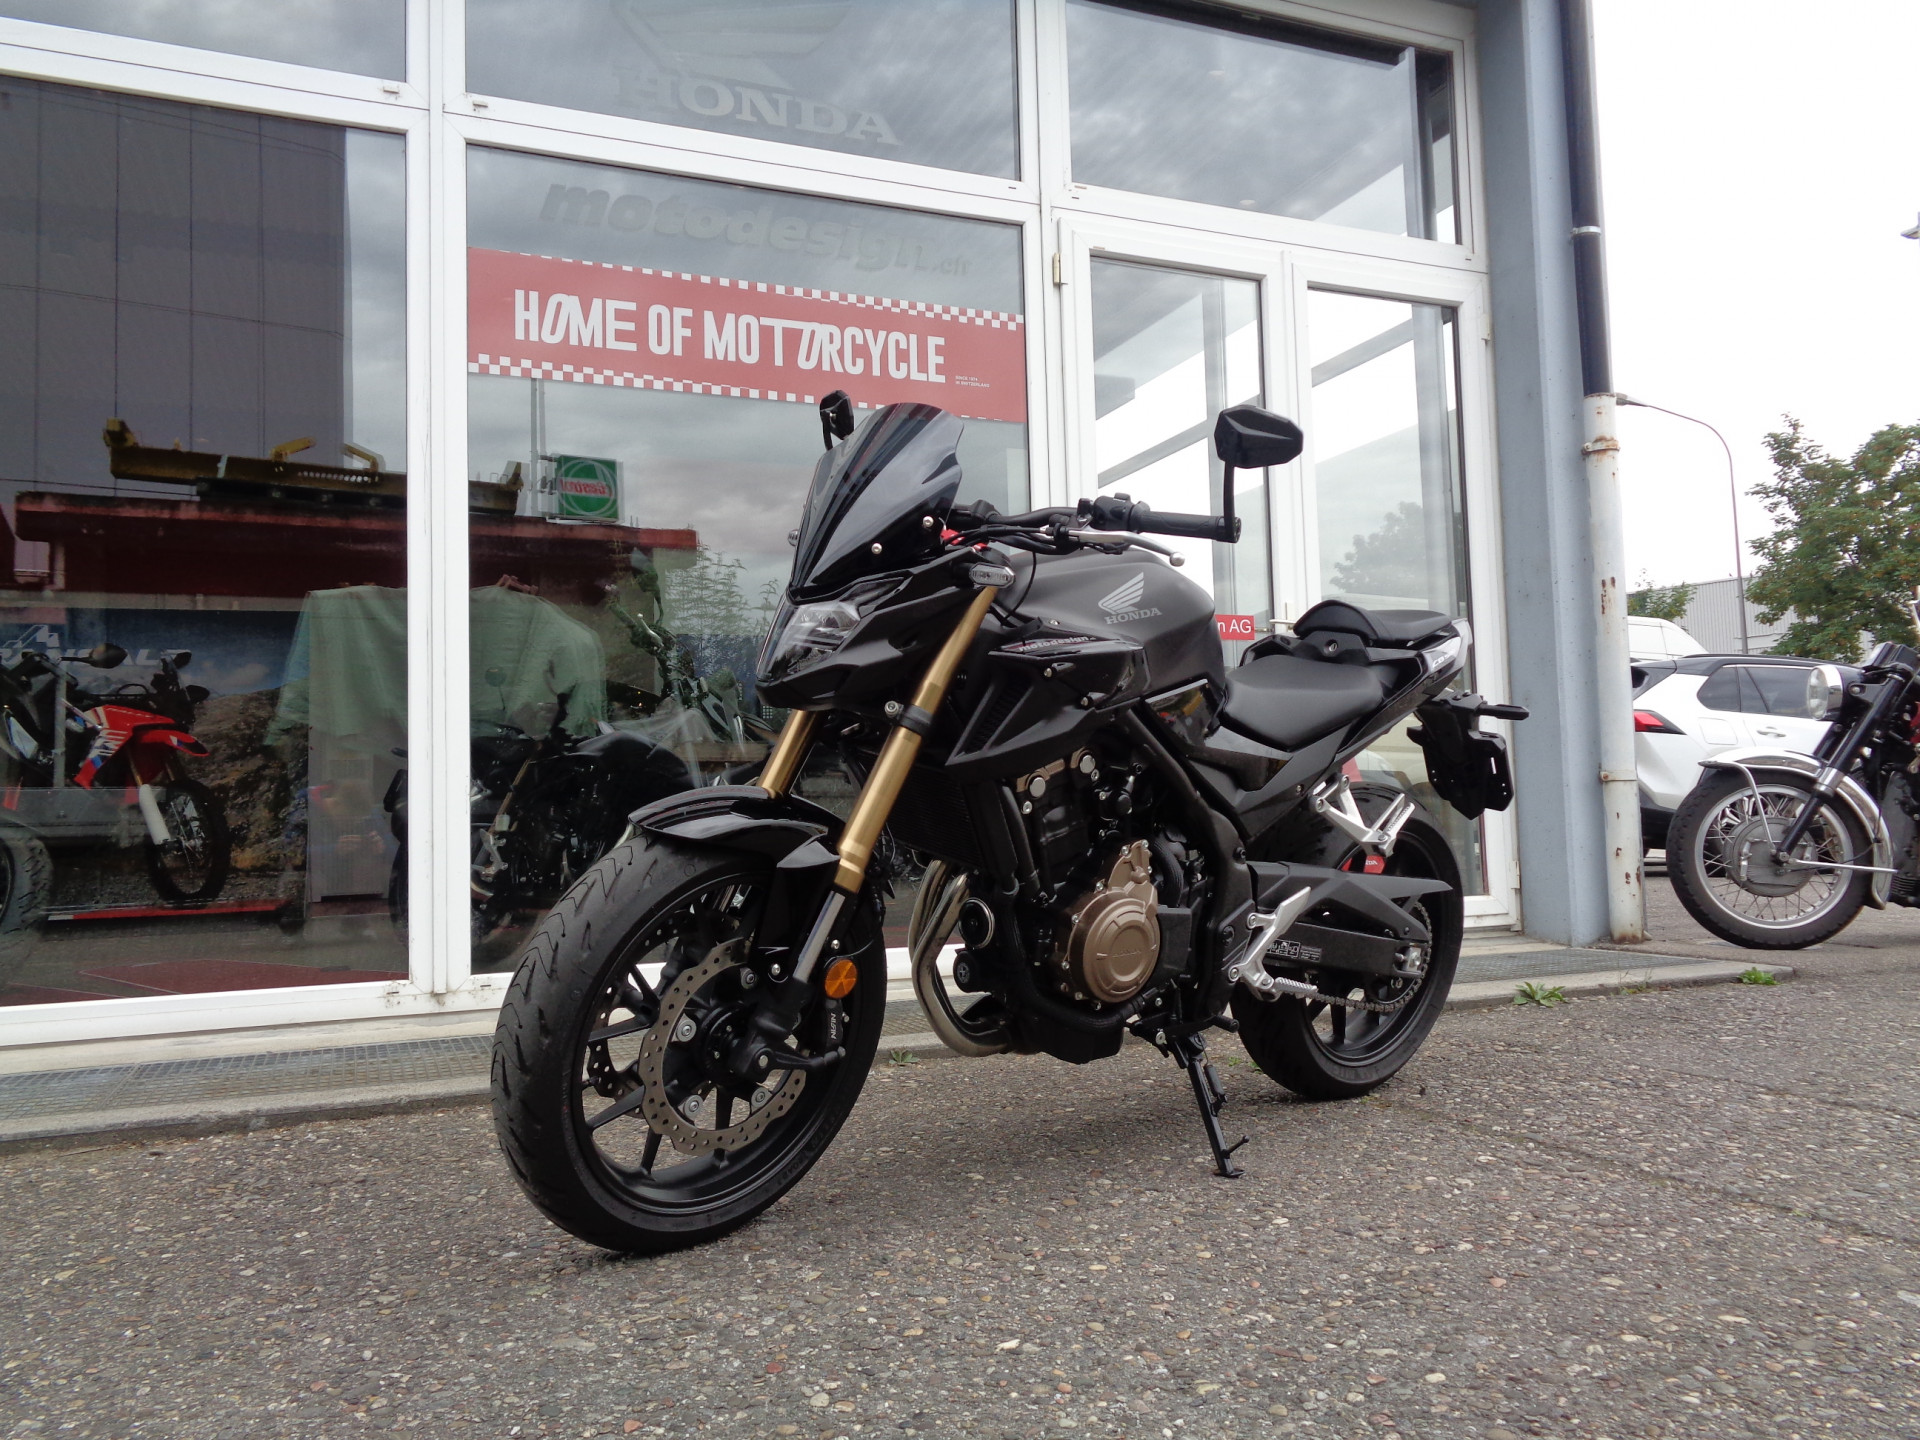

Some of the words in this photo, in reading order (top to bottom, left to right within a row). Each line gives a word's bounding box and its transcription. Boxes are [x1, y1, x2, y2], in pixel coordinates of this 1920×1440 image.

[616, 69, 903, 146] HONDA
[514, 289, 637, 352] HOME
[648, 304, 693, 356] OF
[704, 310, 946, 384] MOTORCYCLE
[1104, 607, 1163, 625] HONDA
[1229, 619, 1252, 633] AG
